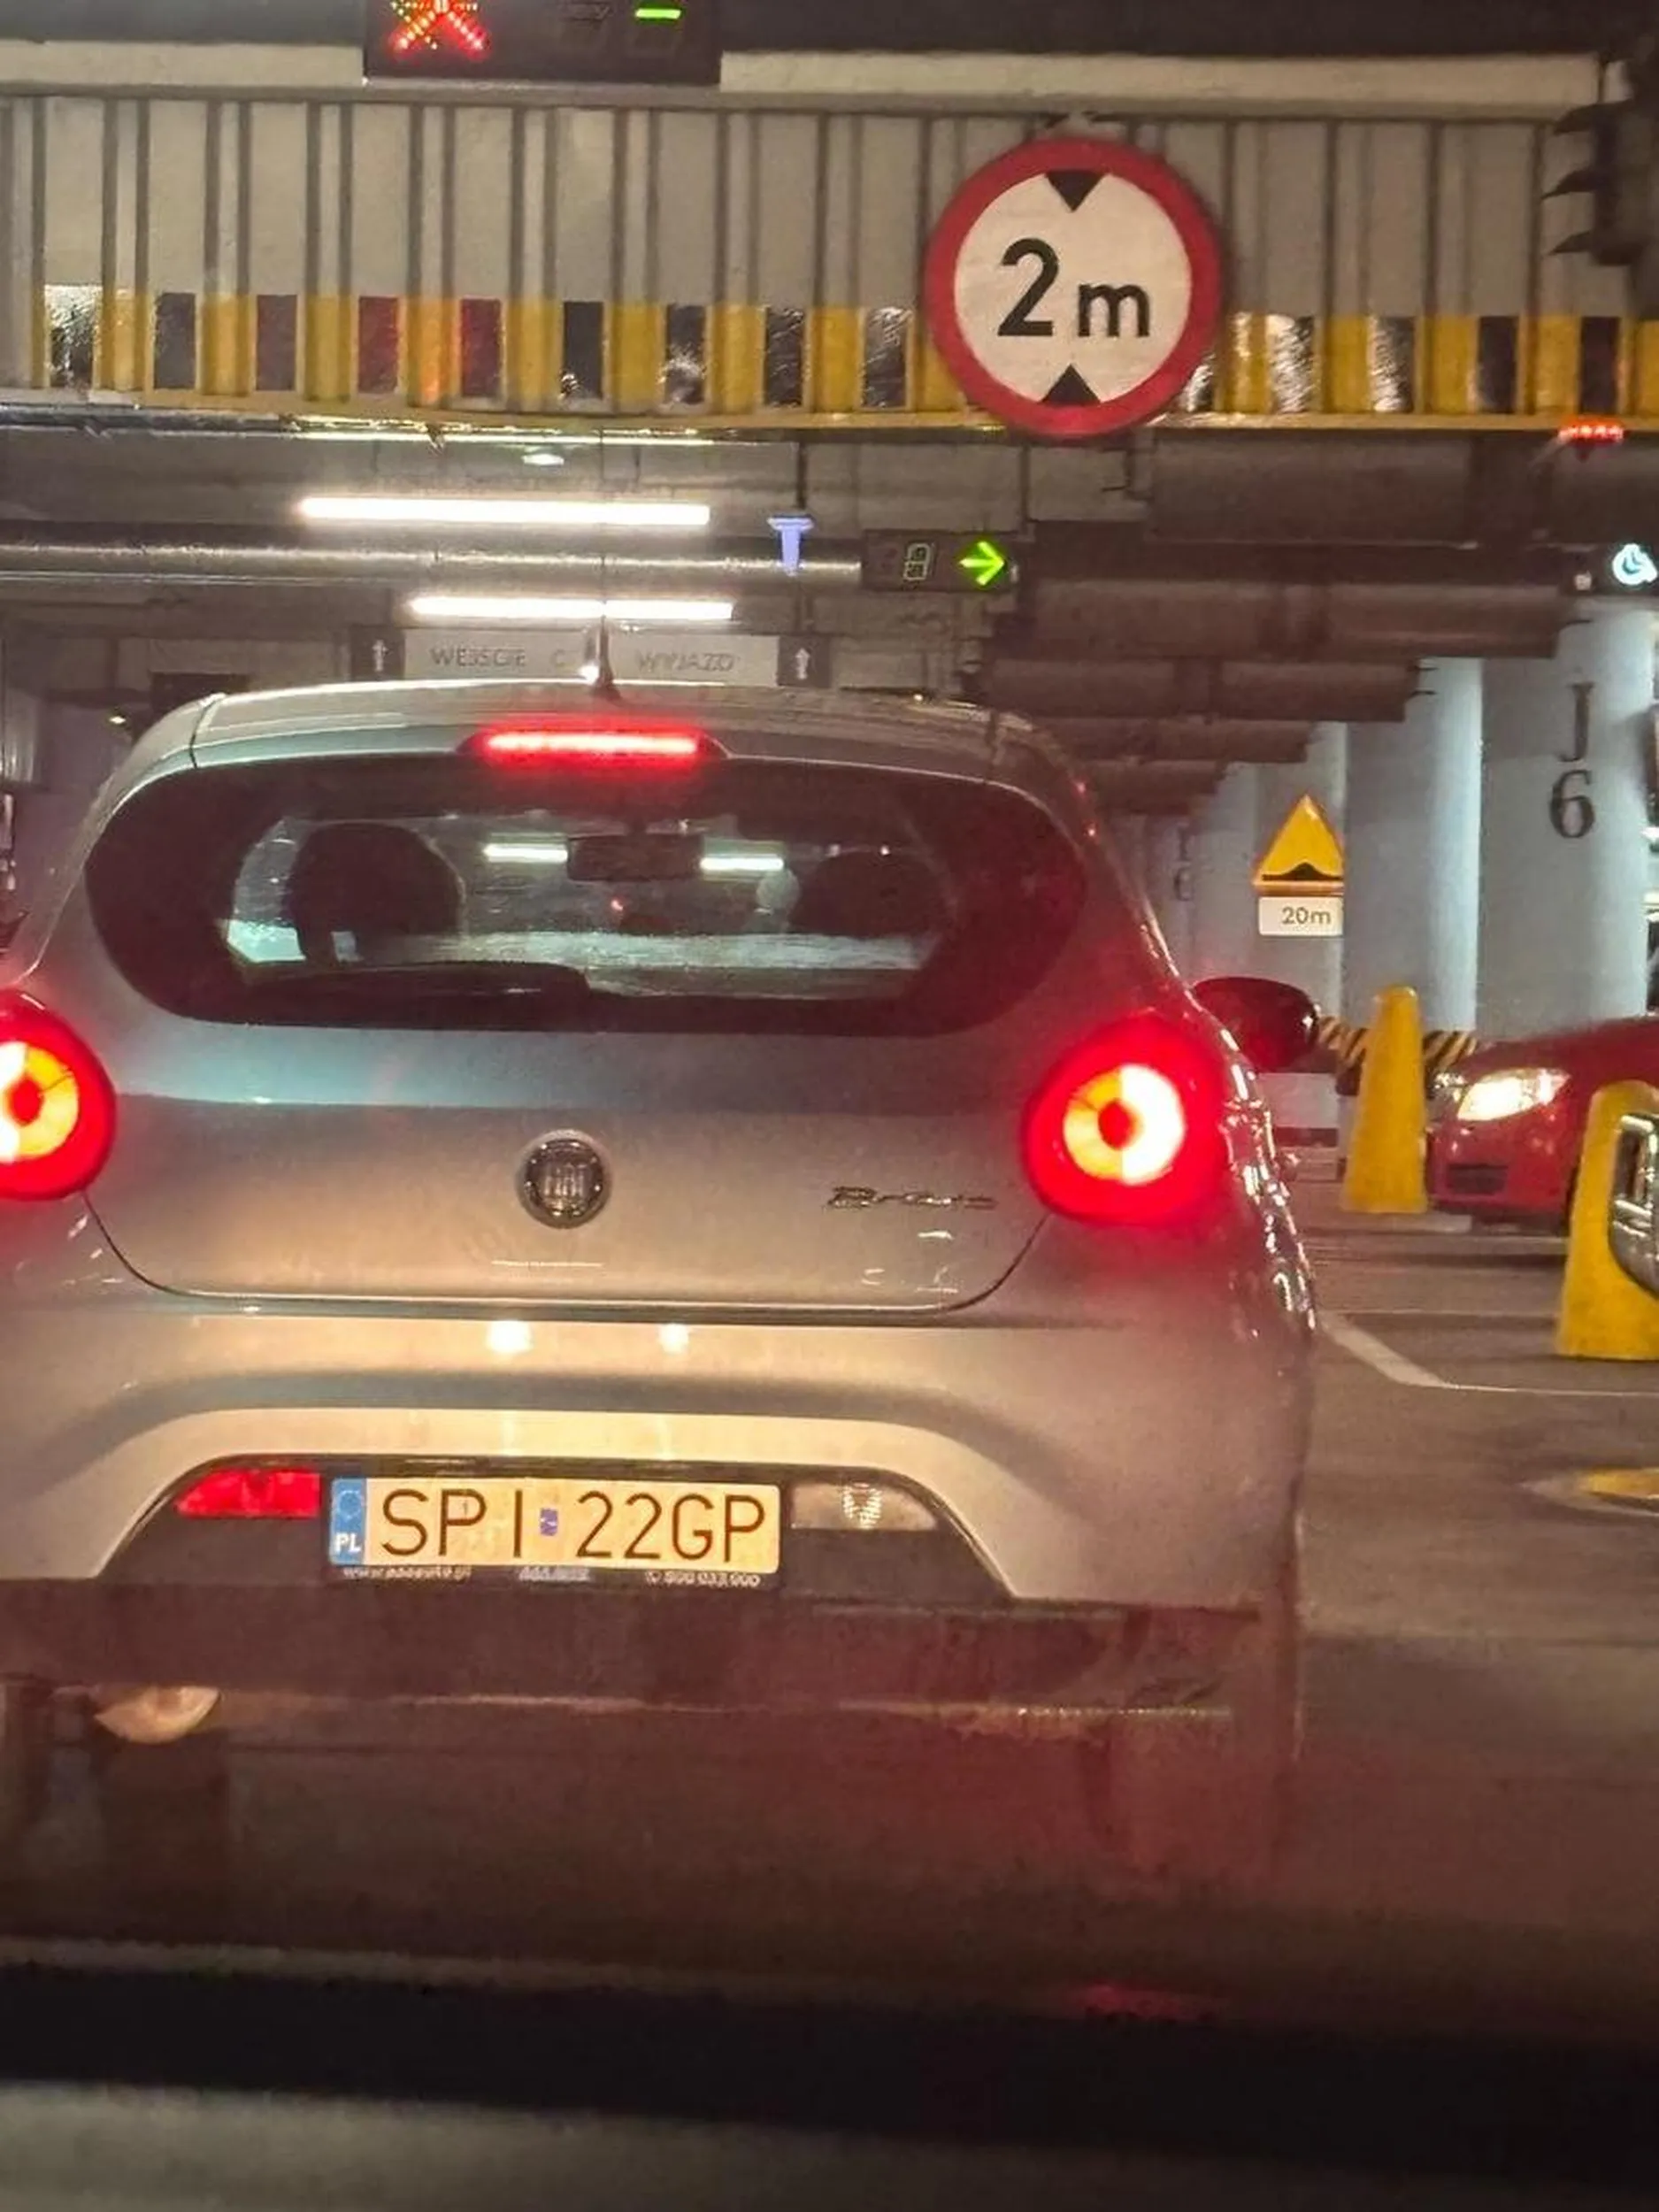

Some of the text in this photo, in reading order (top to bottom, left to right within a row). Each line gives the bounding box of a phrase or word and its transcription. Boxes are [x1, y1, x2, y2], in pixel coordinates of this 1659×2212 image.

[1549, 769, 1596, 840] 6
[334, 1532, 363, 1555] PL
[575, 1489, 766, 1563] 22GP
